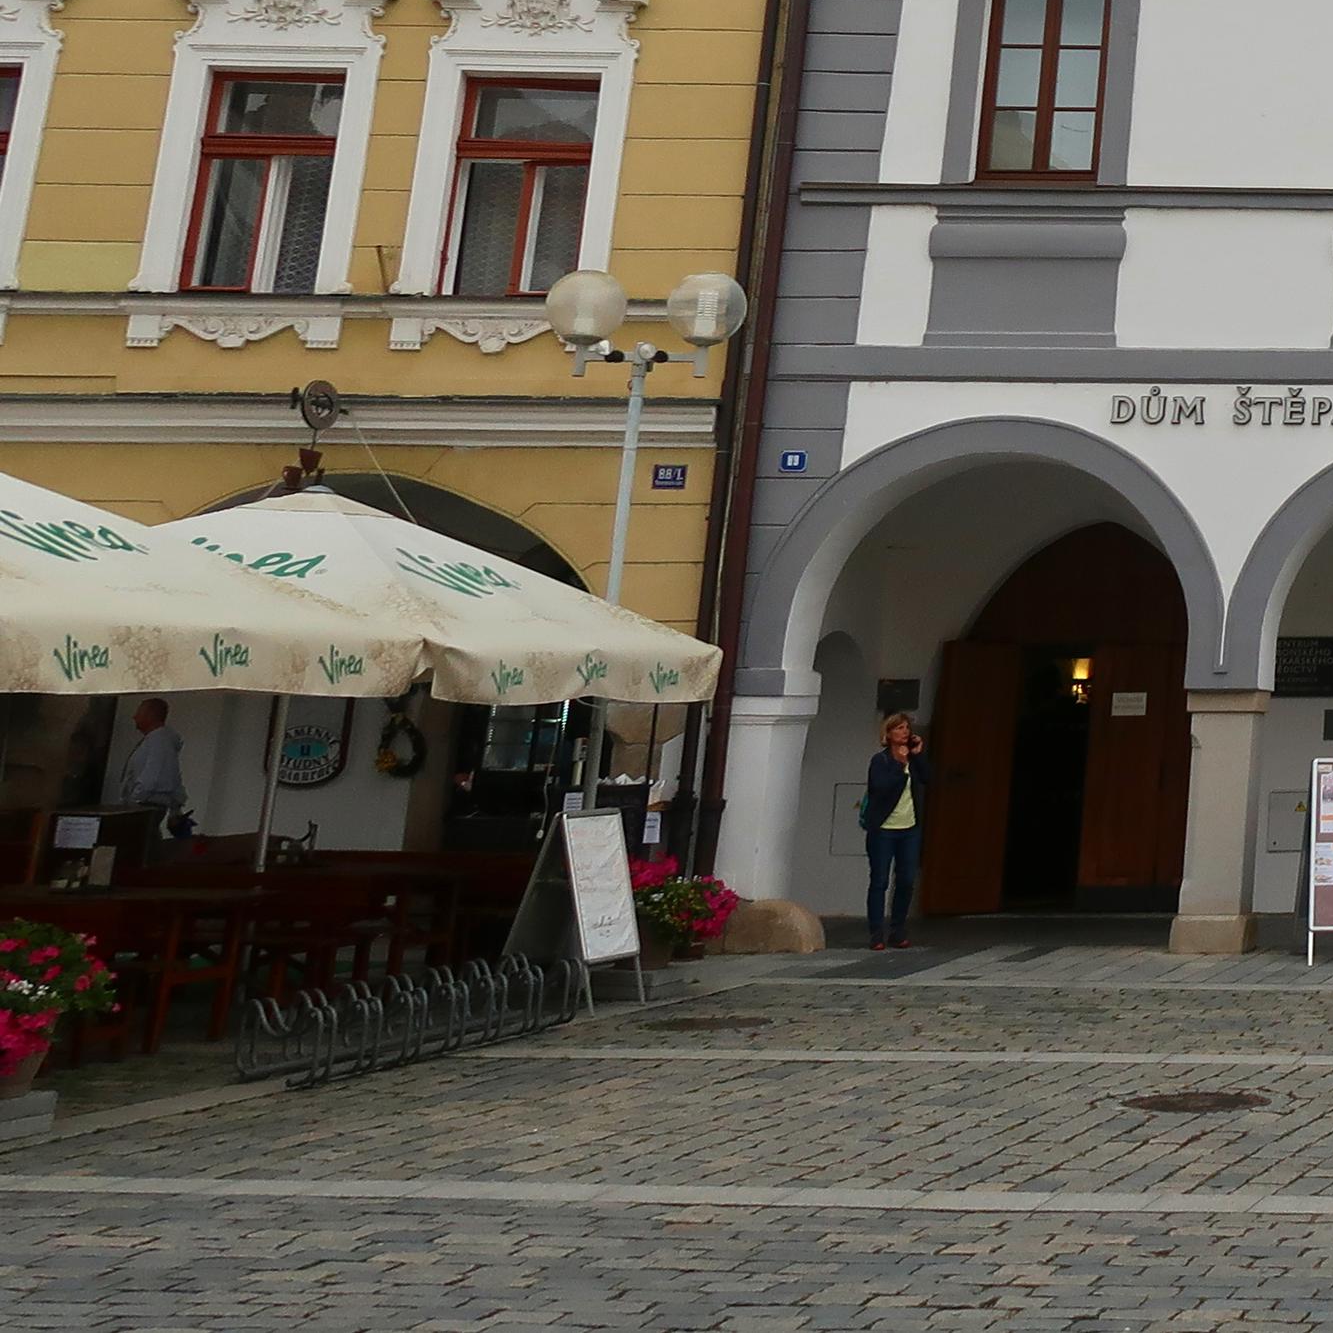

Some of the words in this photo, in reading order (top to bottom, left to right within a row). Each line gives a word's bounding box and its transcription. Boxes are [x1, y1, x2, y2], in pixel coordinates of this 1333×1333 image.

[1110, 386, 1206, 425] DŮM
[396, 547, 518, 599] Vinea
[54, 634, 111, 682] Vinea
[199, 633, 250, 678] Vinea
[318, 644, 365, 685] Vinea
[491, 658, 524, 695] Vinea
[649, 661, 680, 694] Vinea
